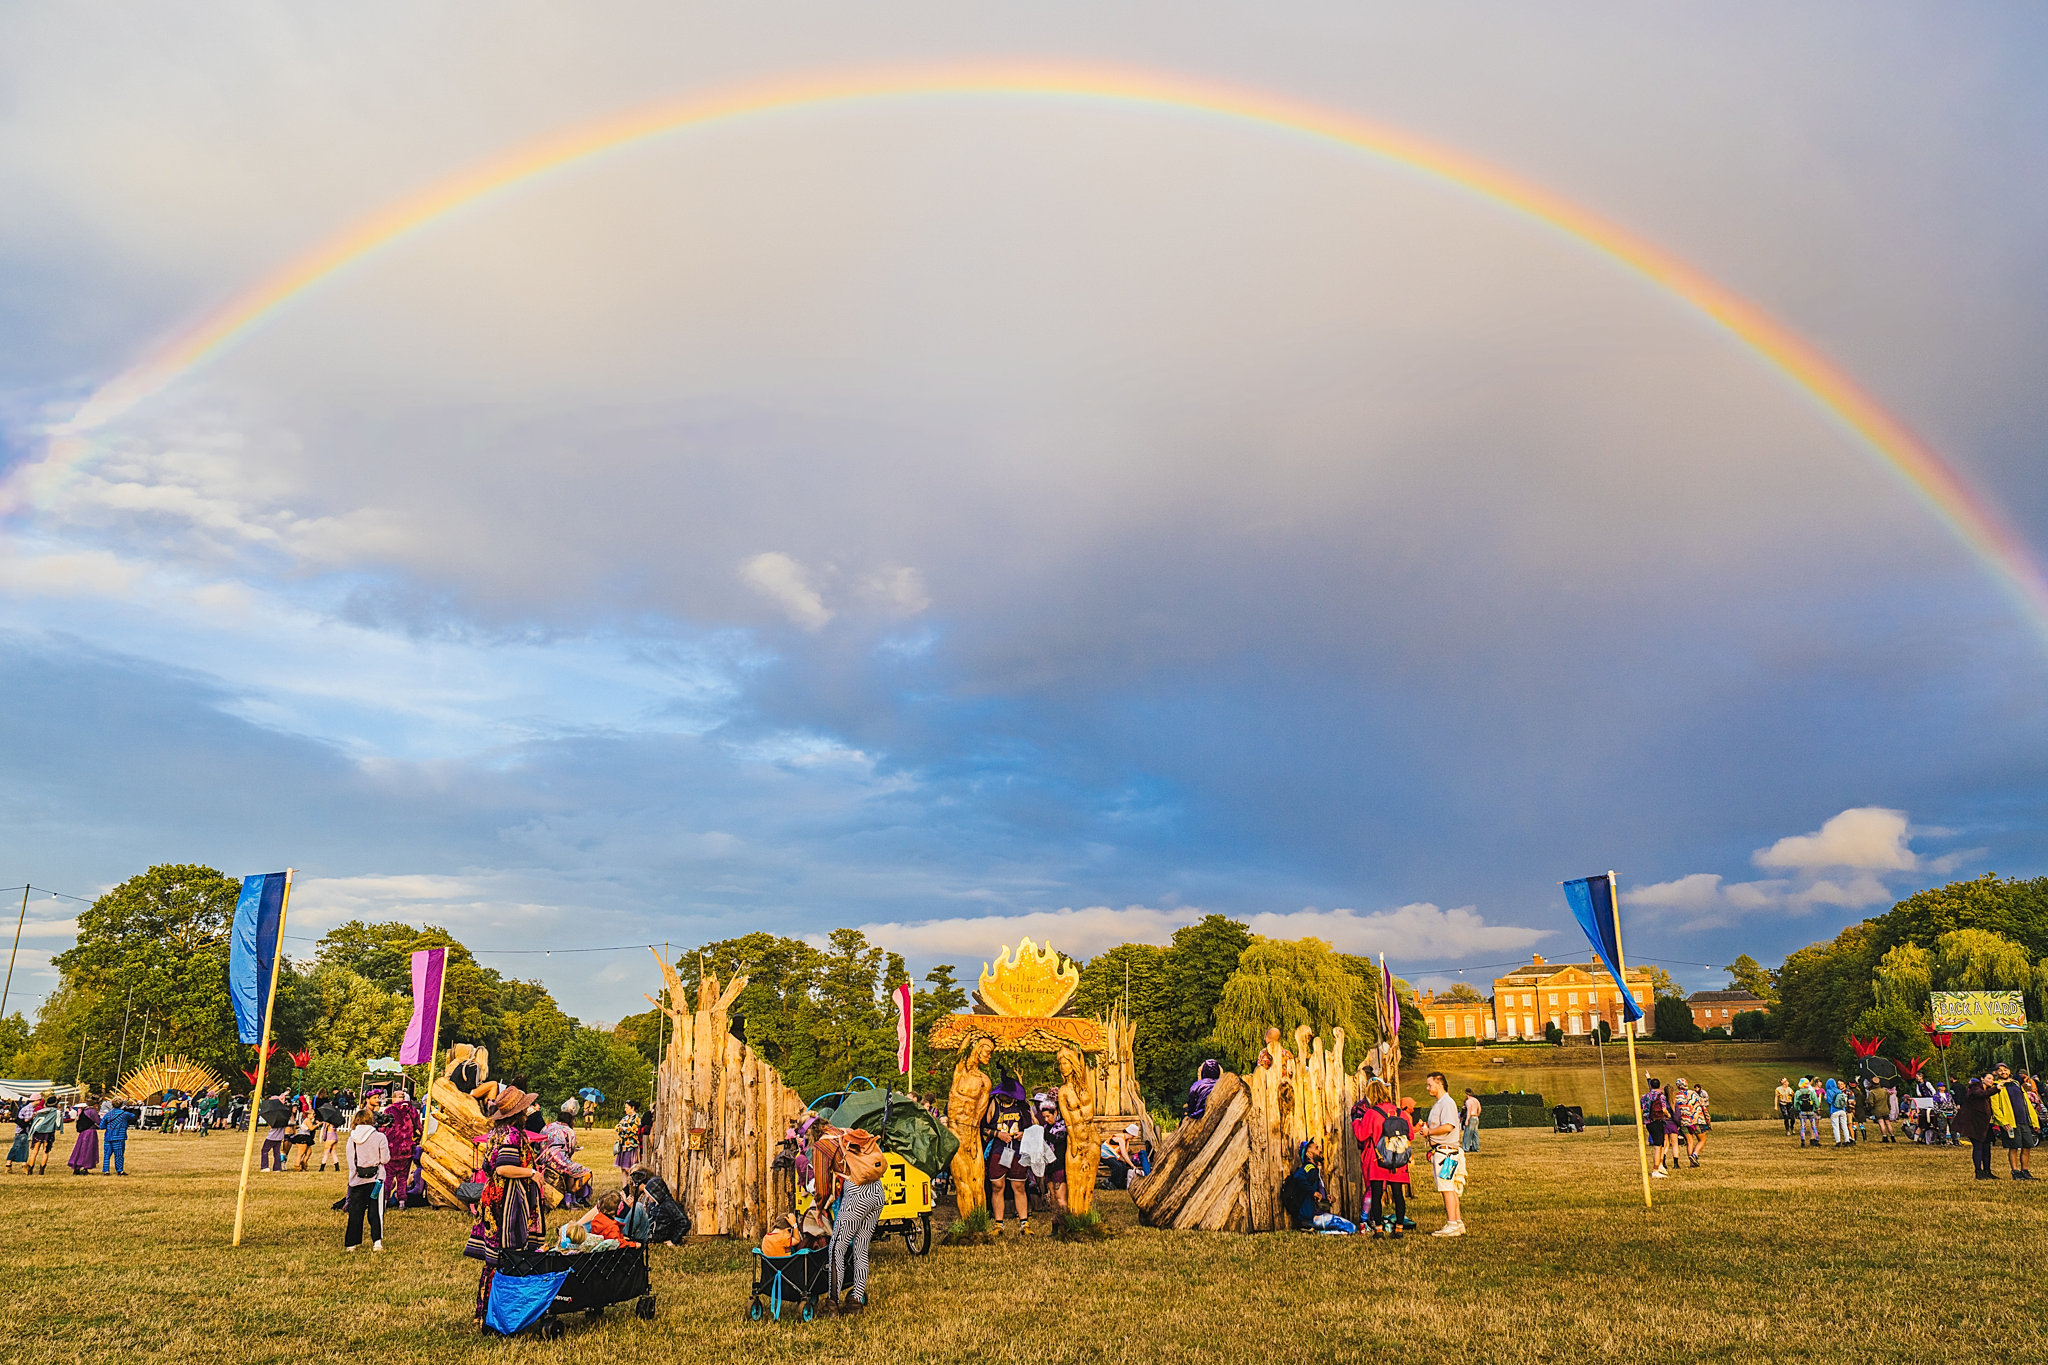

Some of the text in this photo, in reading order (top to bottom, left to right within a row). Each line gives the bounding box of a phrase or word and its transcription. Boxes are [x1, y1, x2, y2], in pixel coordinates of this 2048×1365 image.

[1014, 972, 1036, 981] The
[1000, 982, 1055, 995] Children's
[1940, 1001, 2018, 1016] BACK A YARD
[980, 1016, 1066, 1030] TRANSFORMATION
